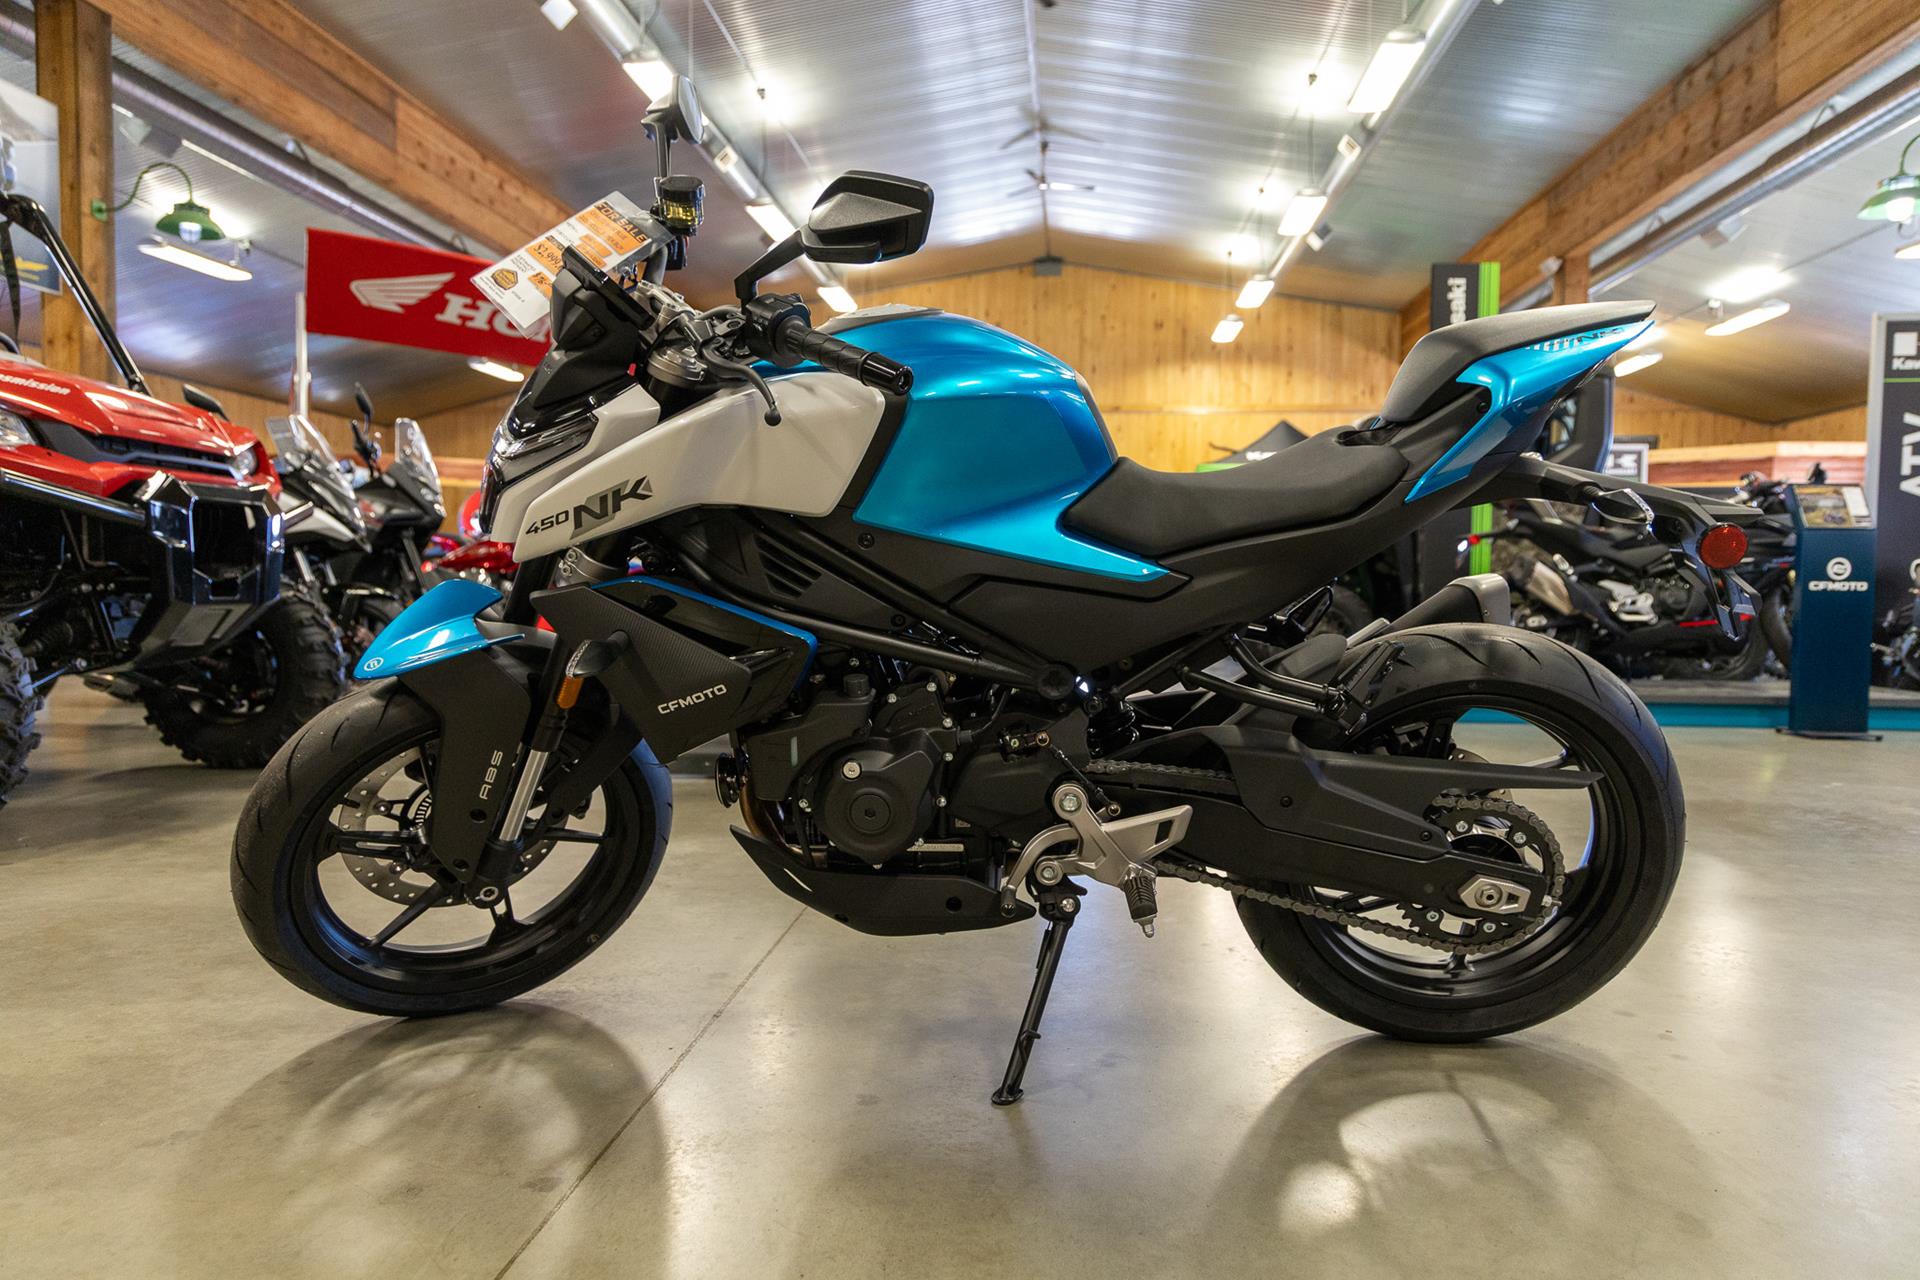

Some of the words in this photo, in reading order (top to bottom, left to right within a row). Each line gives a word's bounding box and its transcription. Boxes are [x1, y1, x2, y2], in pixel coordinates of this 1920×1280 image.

[596, 202, 620, 220] FOR
[617, 216, 648, 243] SALE
[434, 292, 549, 343] HO
[525, 509, 569, 535] 450
[573, 475, 653, 531] NK
[1808, 581, 1869, 592] CFMOTO
[657, 684, 727, 714] CFMOTO
[479, 749, 503, 800] ABS
